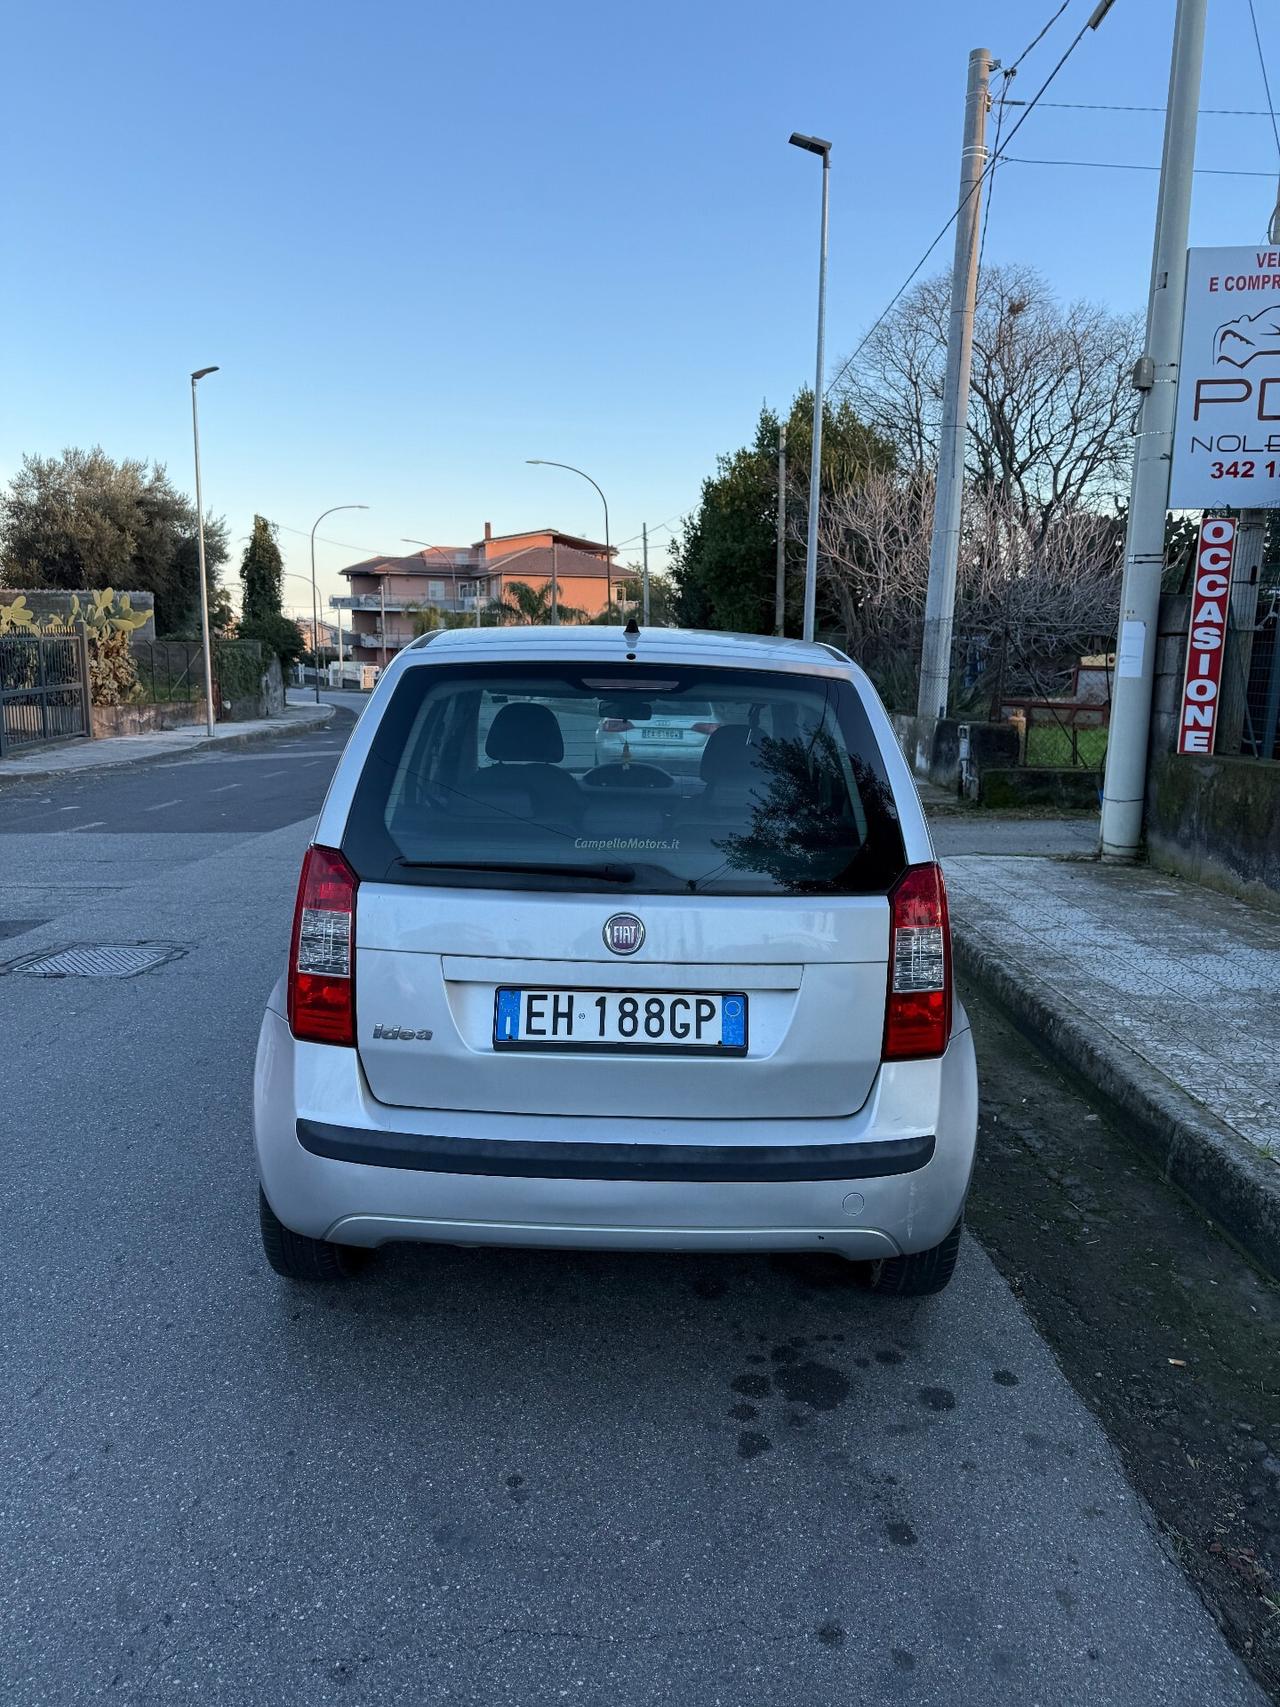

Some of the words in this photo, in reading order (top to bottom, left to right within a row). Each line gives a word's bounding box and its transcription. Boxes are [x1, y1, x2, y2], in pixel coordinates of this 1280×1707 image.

[1256, 252, 1280, 268] VE
[1209, 276, 1219, 292] E
[1210, 461, 1255, 479] 342
[1265, 461, 1280, 478] 1
[1183, 520, 1234, 753] OCCASIONE
[574, 837, 681, 850] CampelloMotors.it
[613, 925, 637, 944] FIAT
[525, 994, 574, 1036] EH
[594, 996, 716, 1039] 188GP
